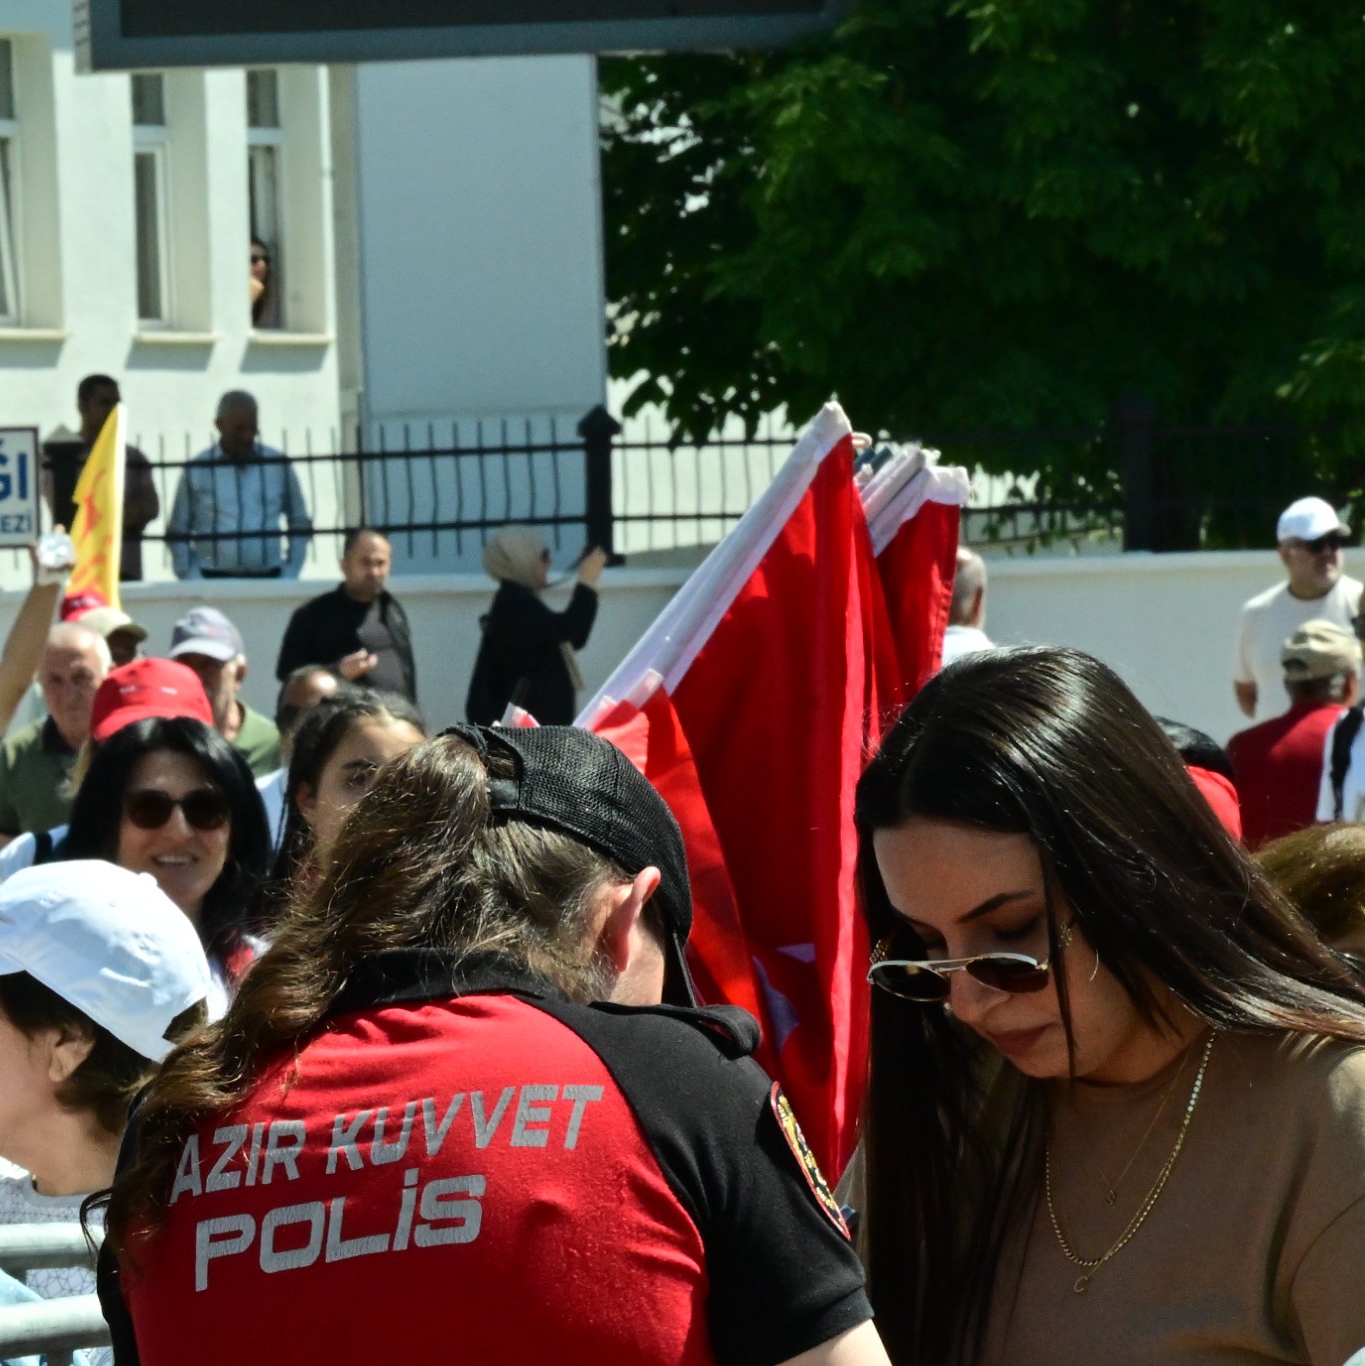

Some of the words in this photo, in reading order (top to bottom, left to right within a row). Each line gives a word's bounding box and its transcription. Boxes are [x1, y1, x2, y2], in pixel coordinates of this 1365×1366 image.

[169, 1120, 307, 1205] AZIR
[325, 1085, 605, 1175] KUVVET
[195, 1167, 486, 1293] POLİS
